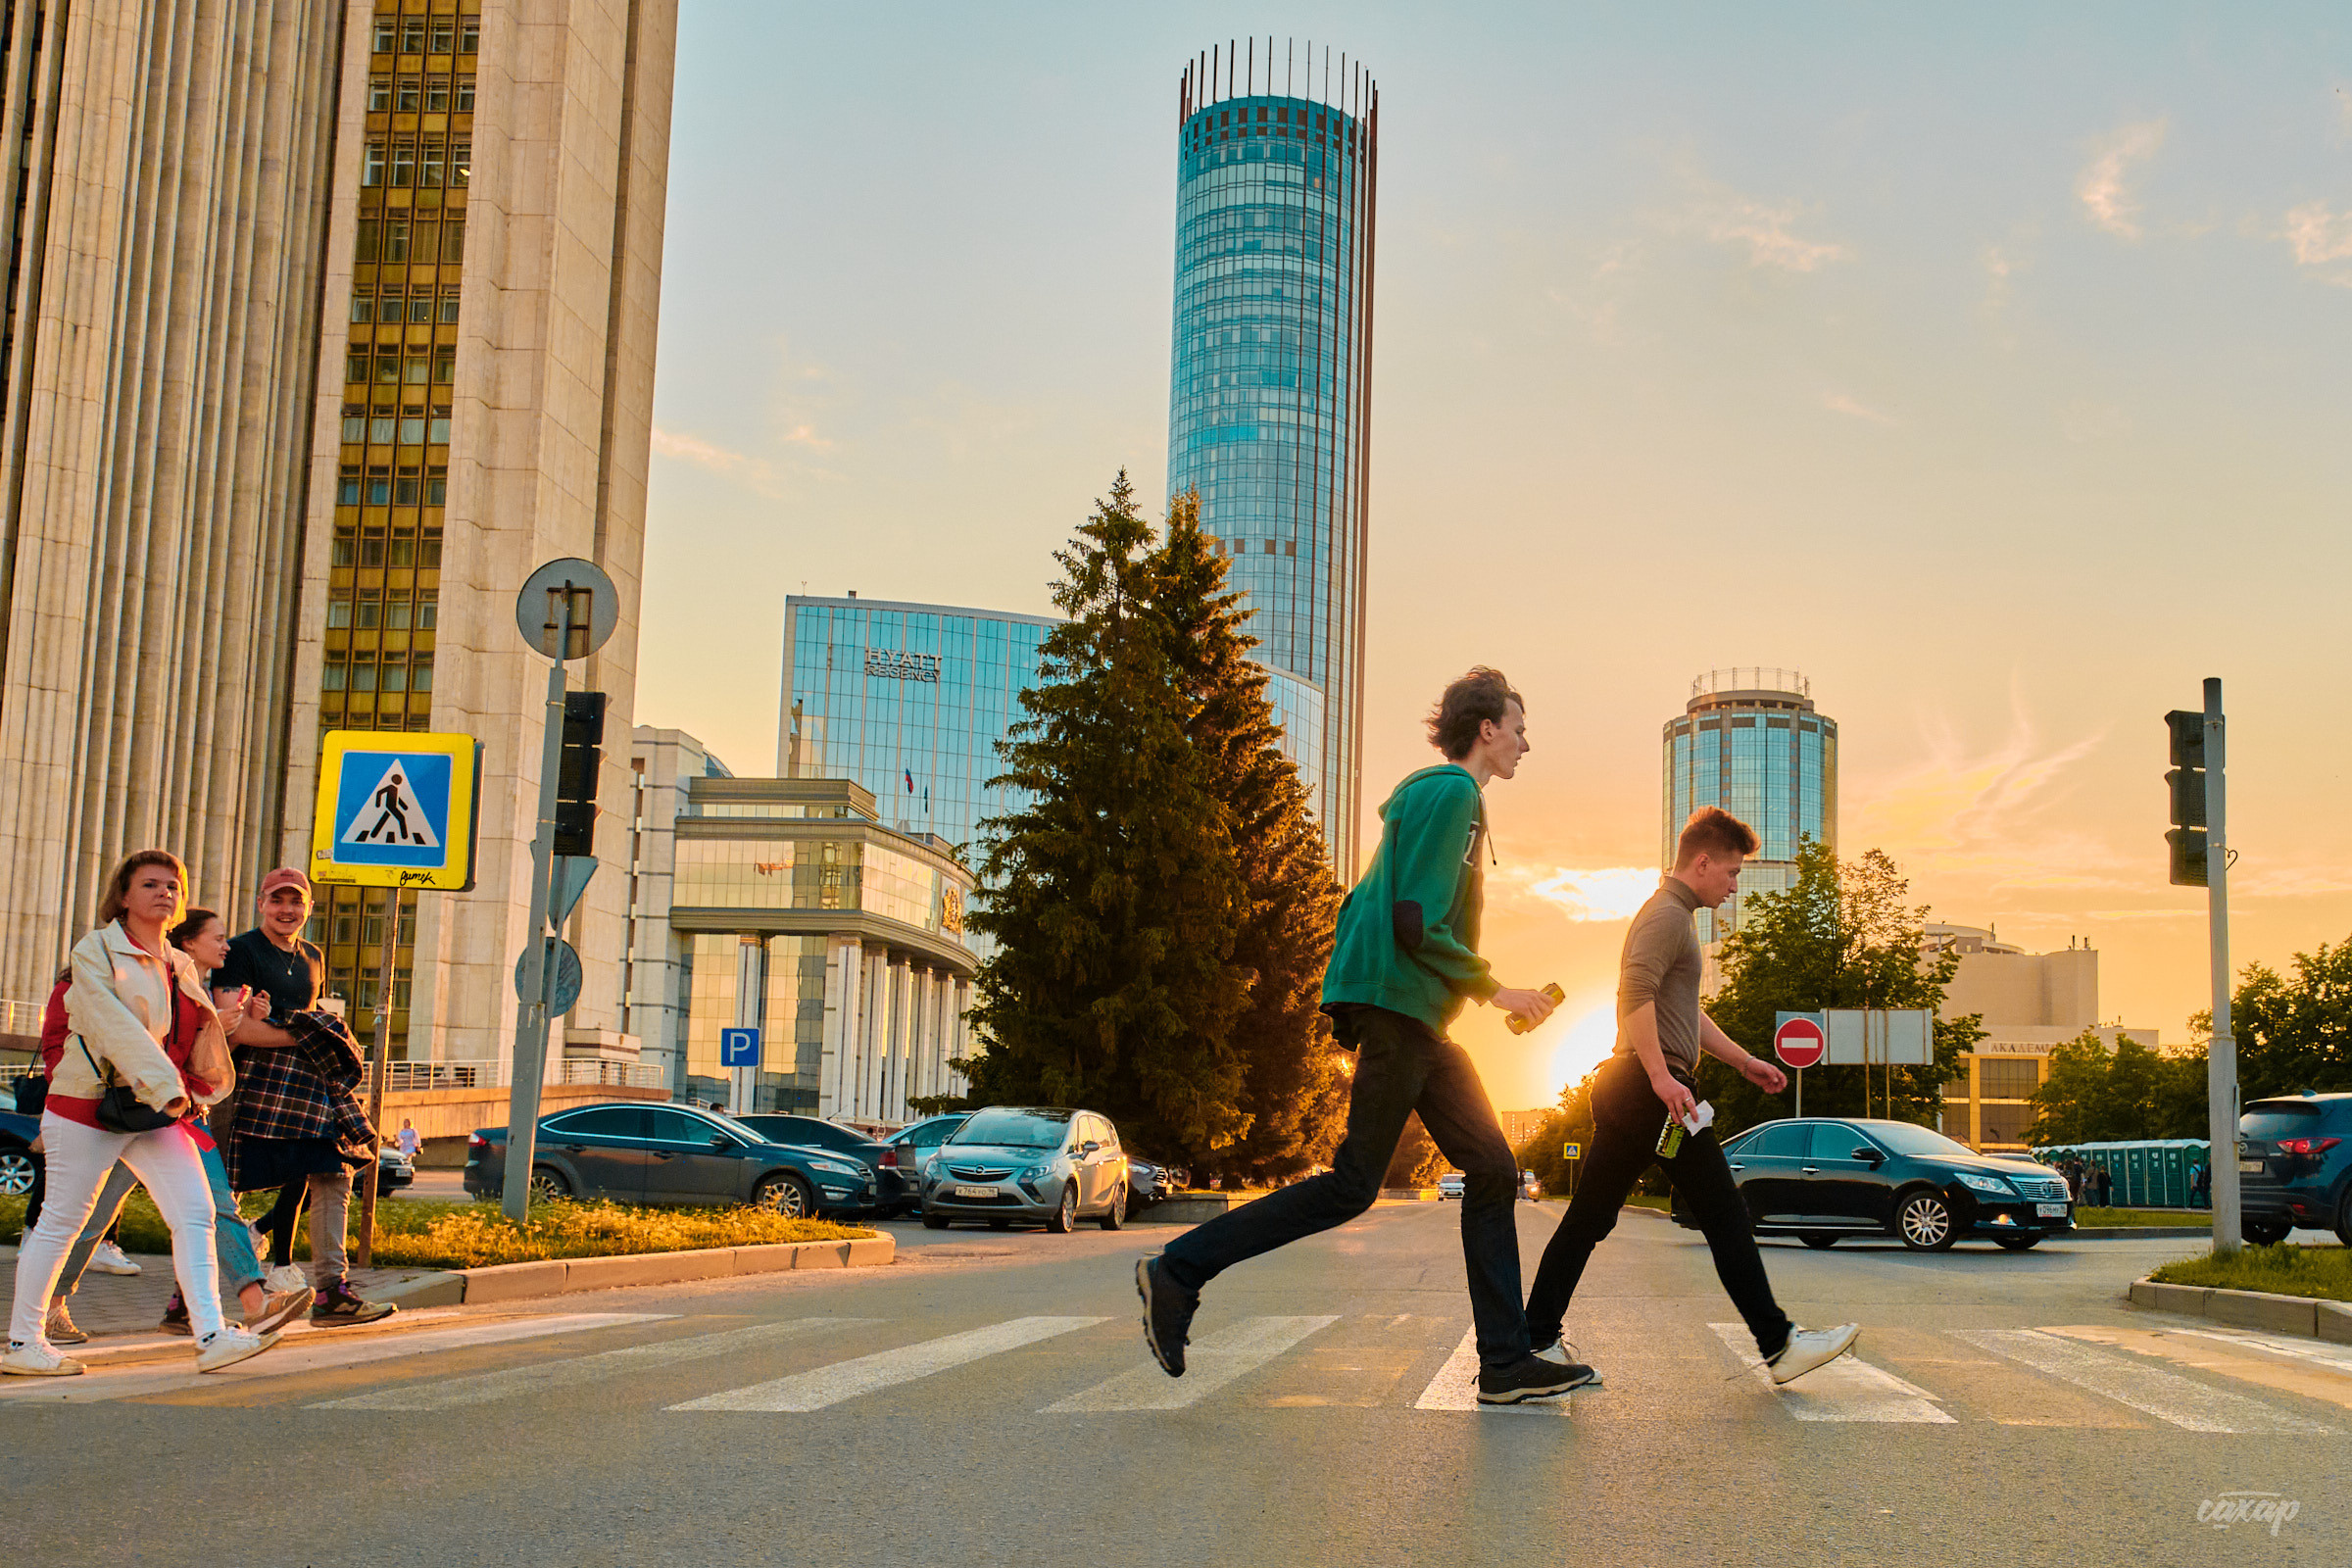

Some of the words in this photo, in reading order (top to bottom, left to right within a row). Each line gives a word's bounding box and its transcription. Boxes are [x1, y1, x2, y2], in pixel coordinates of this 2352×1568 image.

[867, 647, 943, 672] HYATT
[865, 664, 942, 683] REGENCY
[729, 1032, 752, 1063] P
